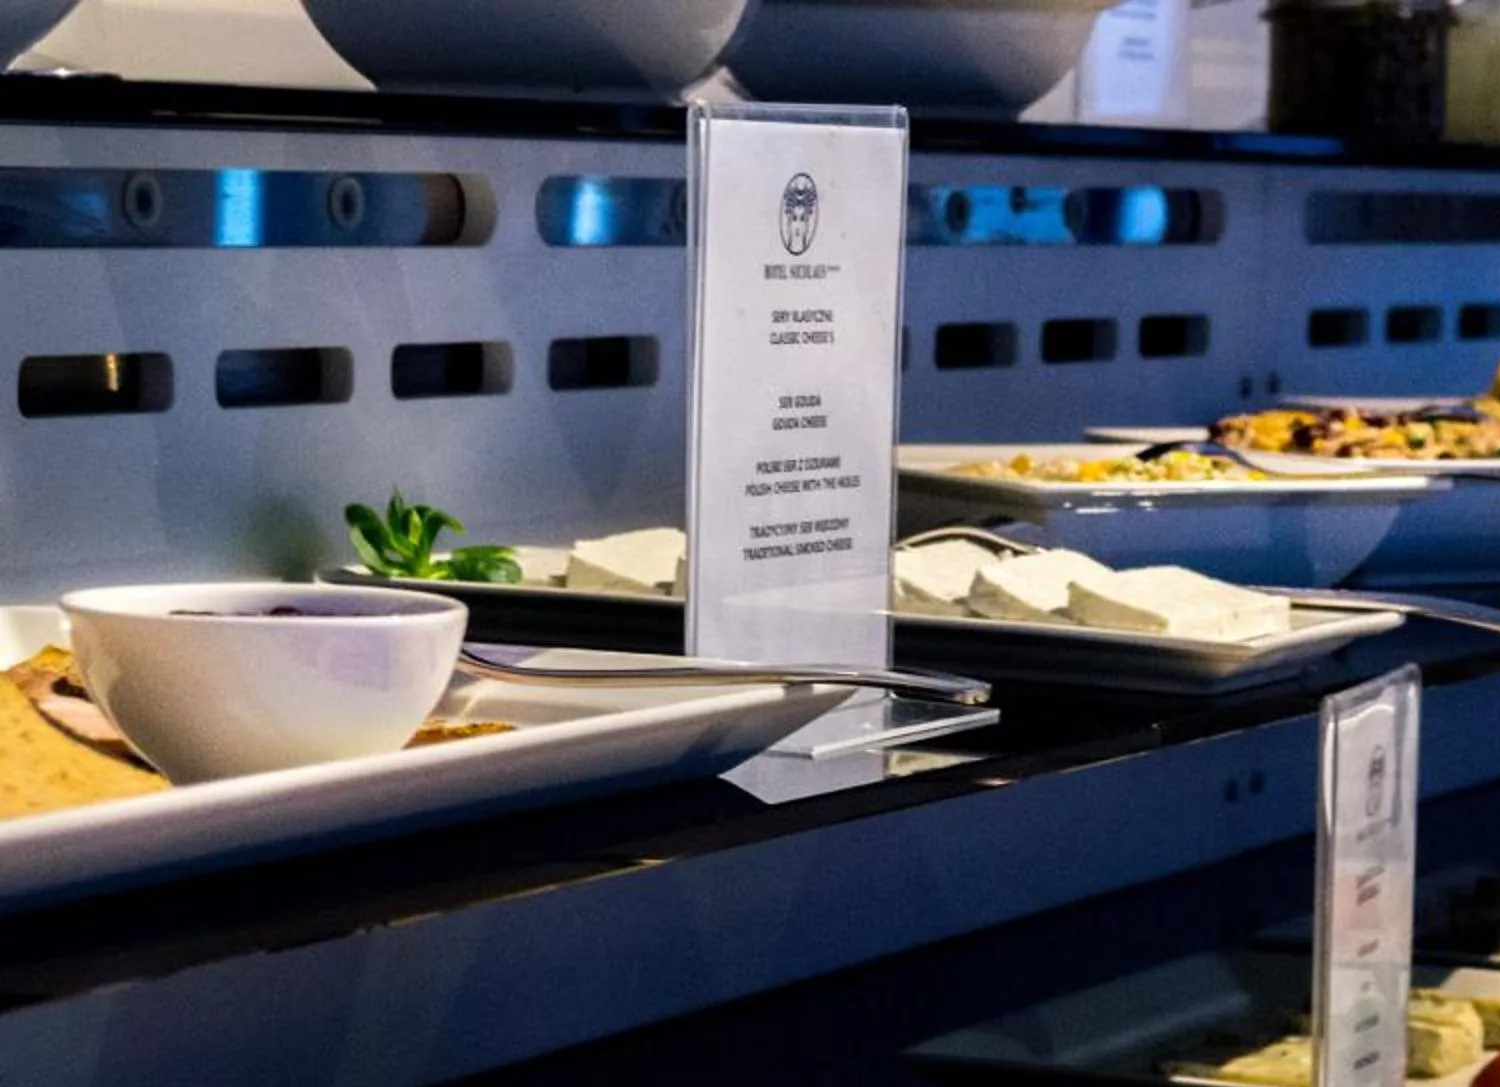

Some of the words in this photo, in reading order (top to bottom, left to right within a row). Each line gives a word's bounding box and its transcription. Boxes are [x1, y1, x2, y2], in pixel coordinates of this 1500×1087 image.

[795, 394, 821, 408] GOUDA
[773, 417, 798, 430] GOUDA
[800, 415, 827, 428] CHEESE
[745, 483, 771, 497] POLISH
[773, 480, 801, 494] CHEESE
[802, 478, 820, 491] WITH
[822, 476, 835, 489] THE
[826, 537, 853, 552] CHEESE
